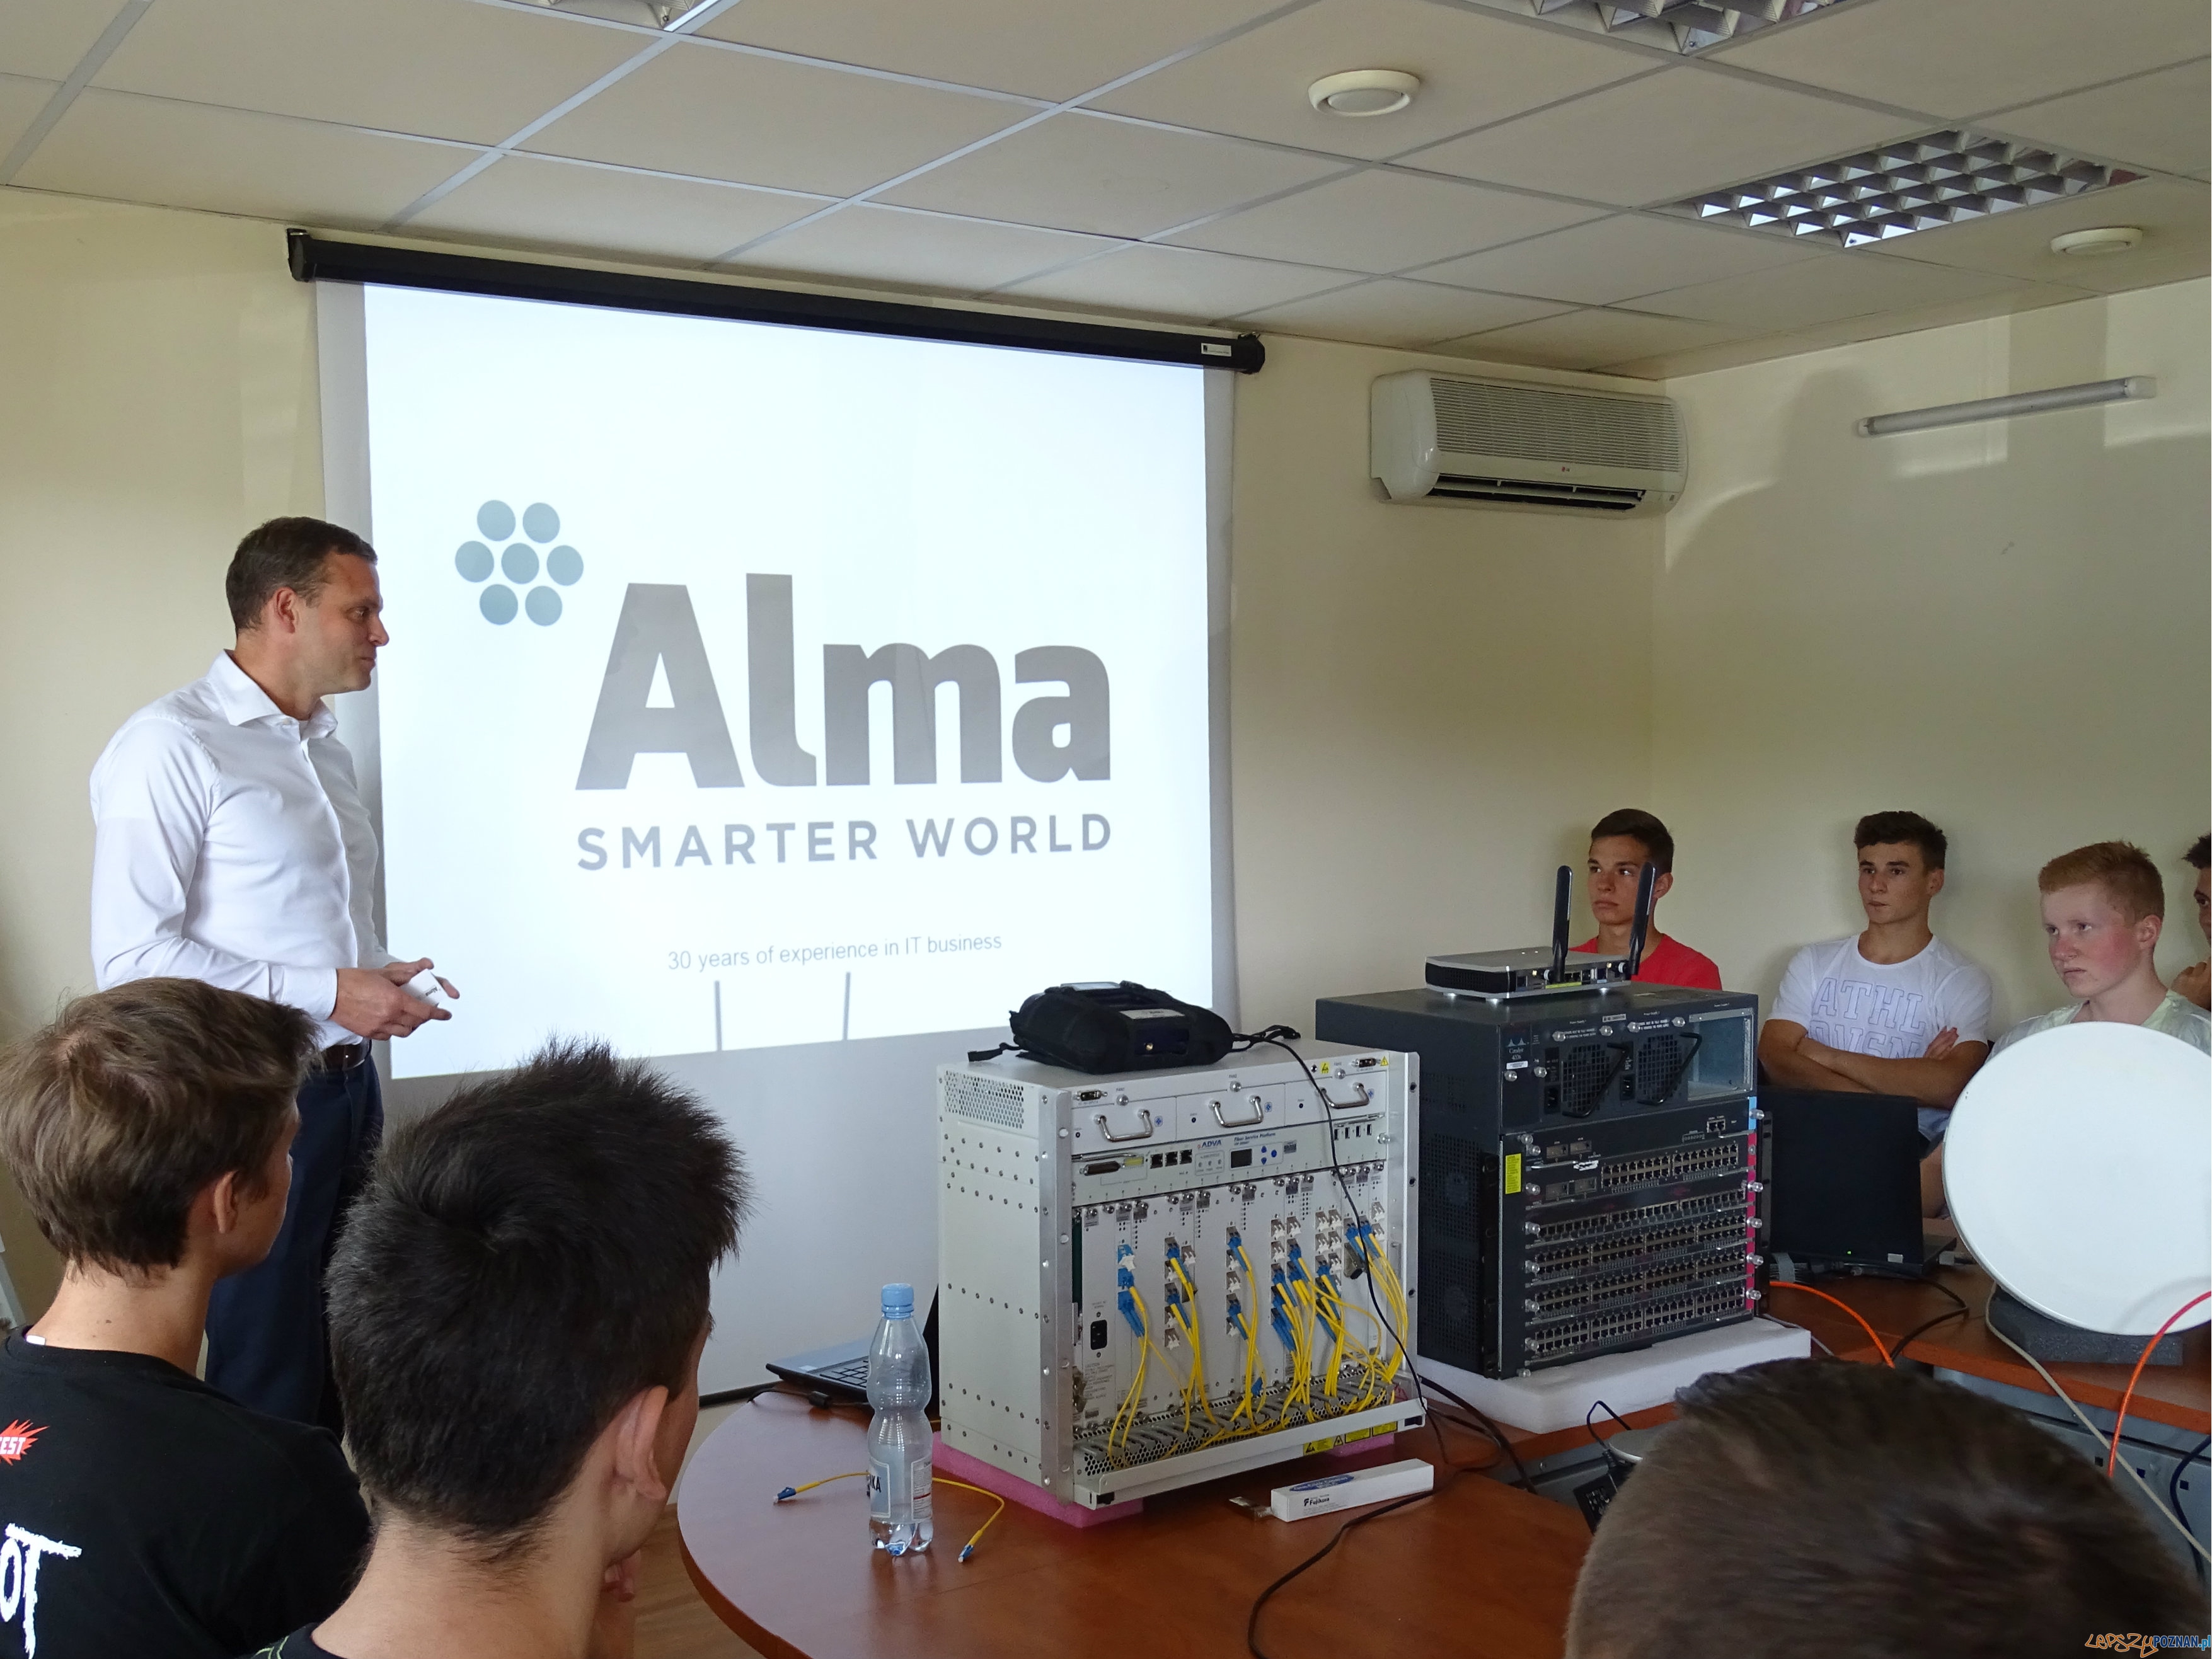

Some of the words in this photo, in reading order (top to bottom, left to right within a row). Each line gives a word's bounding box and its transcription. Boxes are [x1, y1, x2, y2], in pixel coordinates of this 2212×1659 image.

[575, 571, 1112, 791] Alma
[577, 820, 878, 871] SMARTER
[905, 813, 1112, 859] WORLD
[668, 950, 691, 970] 30
[698, 951, 750, 973] years
[756, 944, 775, 965] of
[779, 942, 878, 966] experience
[884, 939, 899, 957] in
[905, 936, 922, 955] IT
[927, 934, 1003, 954] business
[1811, 977, 1927, 1036] ATHL
[1201, 1139, 1222, 1149] ADVA
[1310, 1497, 1330, 1505] Fujikura
